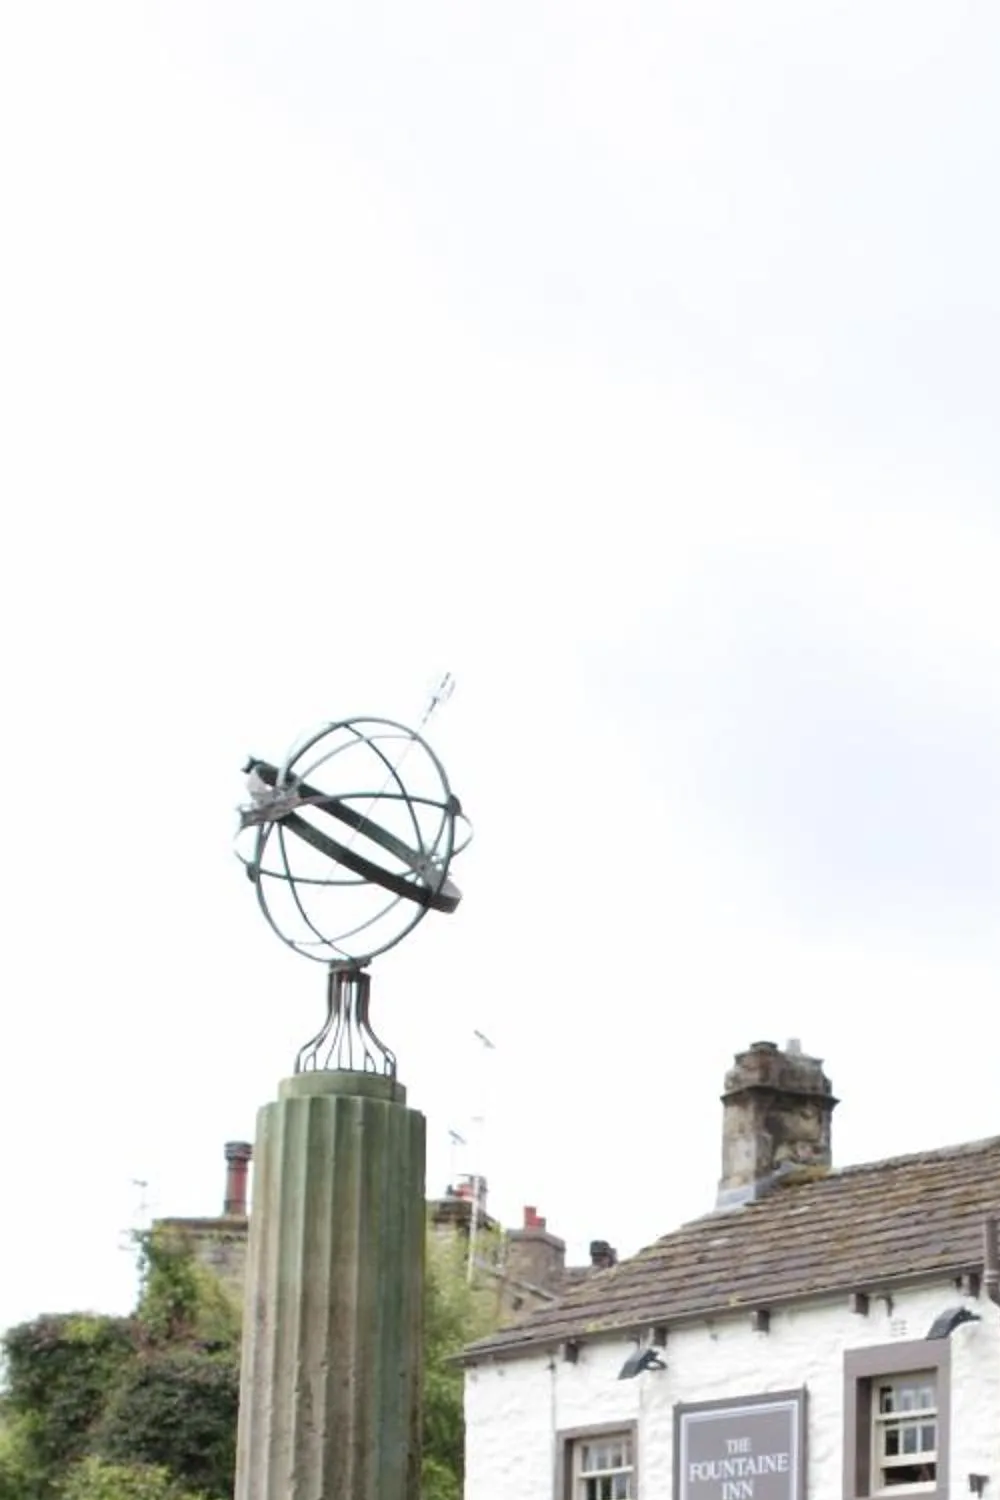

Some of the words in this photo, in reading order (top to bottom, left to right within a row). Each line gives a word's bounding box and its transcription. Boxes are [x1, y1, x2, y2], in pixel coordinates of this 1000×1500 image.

[726, 1437, 751, 1453] THE
[689, 1453, 789, 1482] FOUNTAINE
[722, 1480, 753, 1500] INN
